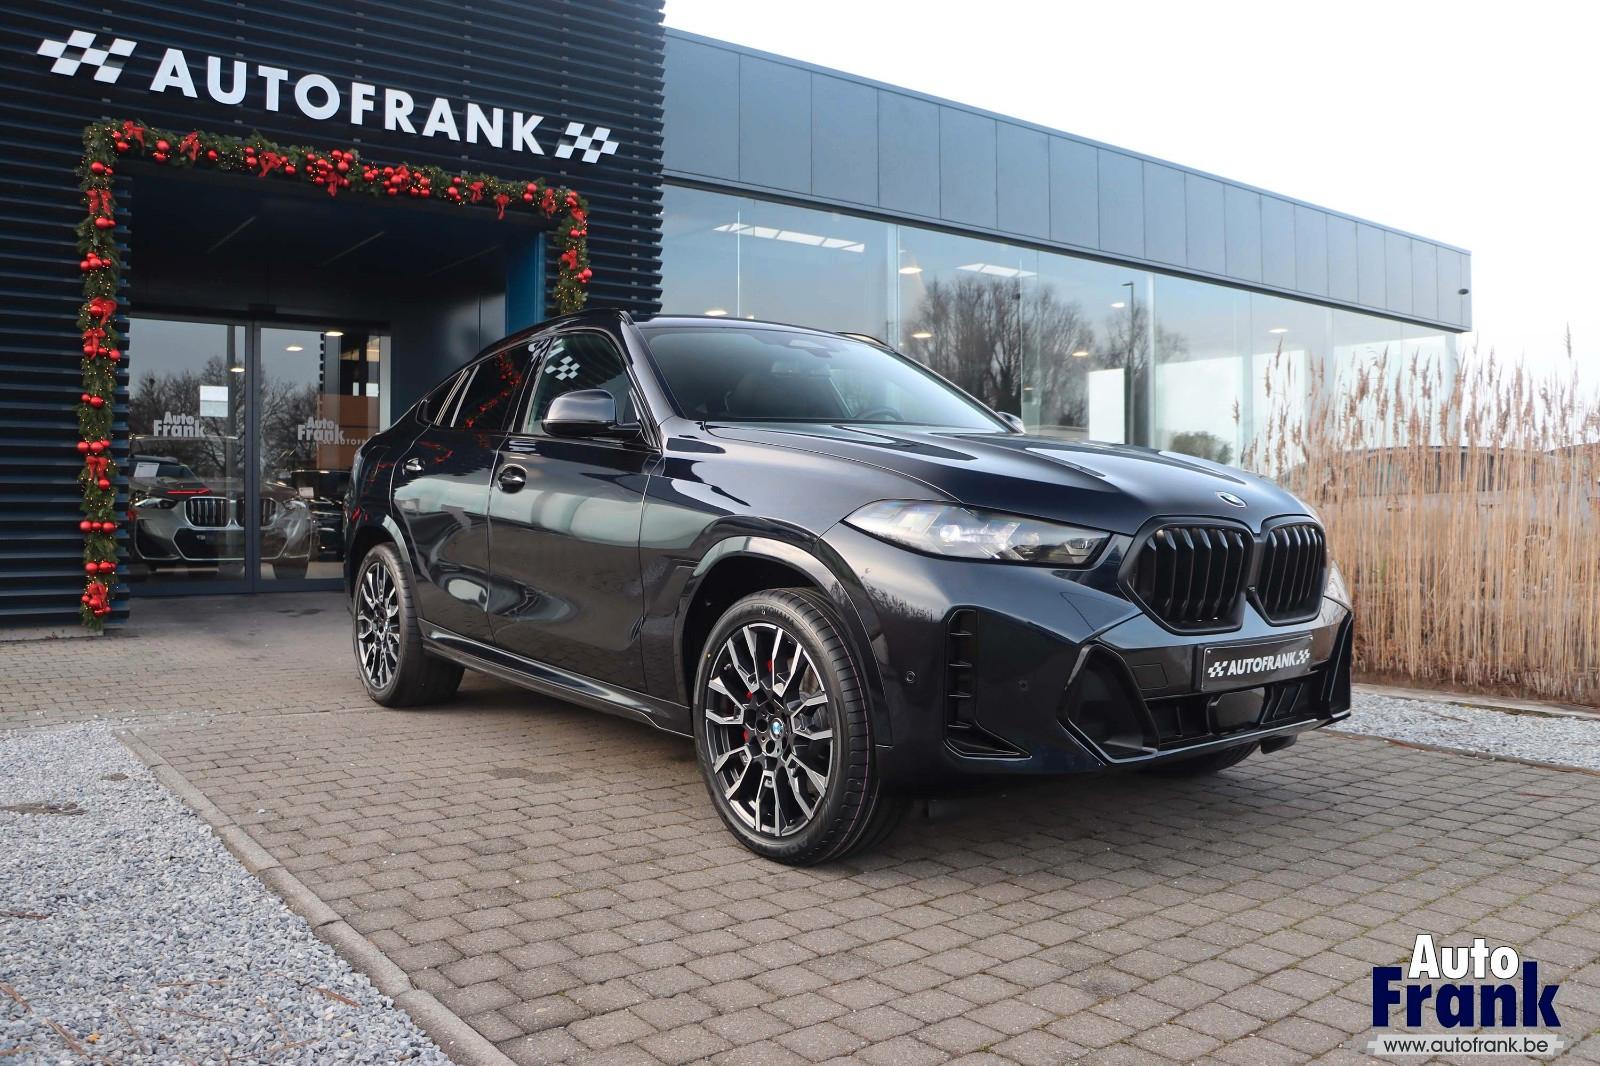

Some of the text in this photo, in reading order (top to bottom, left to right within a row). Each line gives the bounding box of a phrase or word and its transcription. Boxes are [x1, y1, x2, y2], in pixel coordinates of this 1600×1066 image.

[149, 47, 545, 156] AUTOFRANK
[163, 411, 195, 425] Auto
[306, 416, 335, 429] Auto
[153, 419, 206, 438] Frank
[297, 424, 344, 441] Frank
[1227, 651, 1296, 676] AUTOFRANK
